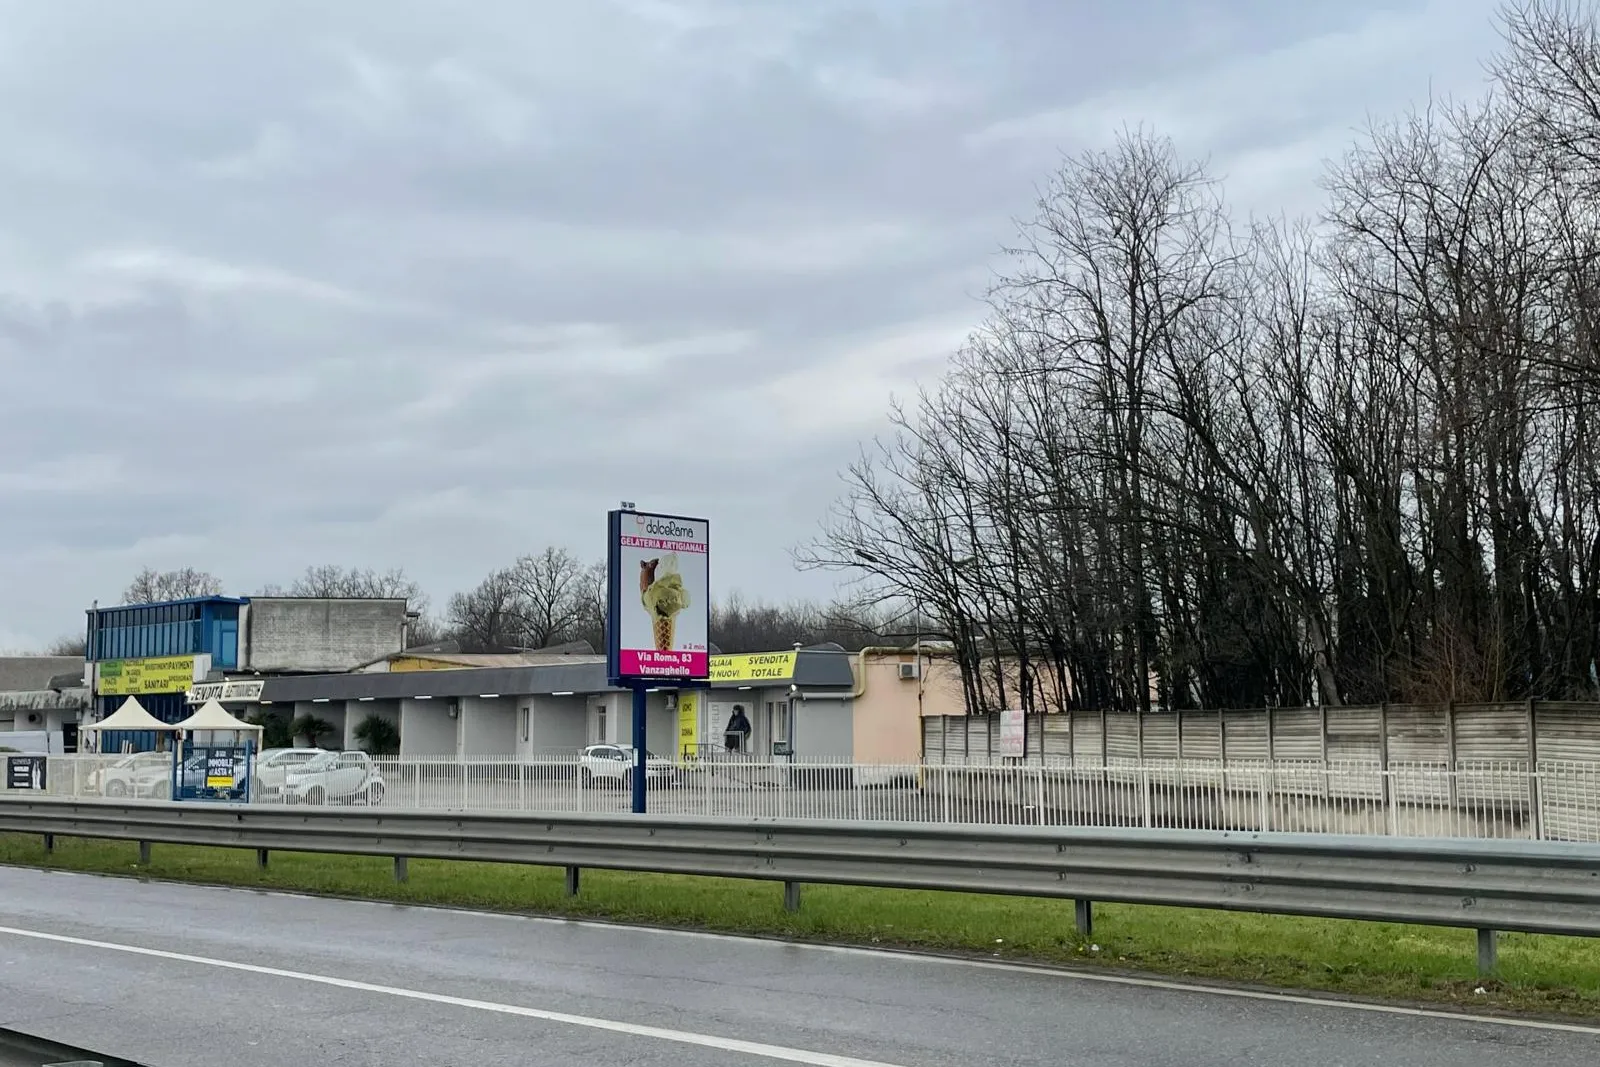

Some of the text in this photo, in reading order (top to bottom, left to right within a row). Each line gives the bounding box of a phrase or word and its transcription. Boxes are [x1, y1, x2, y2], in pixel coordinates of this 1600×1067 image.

[646, 519, 694, 538] dolceRama
[621, 536, 707, 553] GELATERIA ARTIGIANALE
[637, 652, 692, 664] Via Roma, 83
[748, 655, 789, 665] SVENDITA
[639, 664, 690, 676] Vanzaghello
[716, 669, 740, 678] NUOVI
[751, 667, 783, 677] TOTALE
